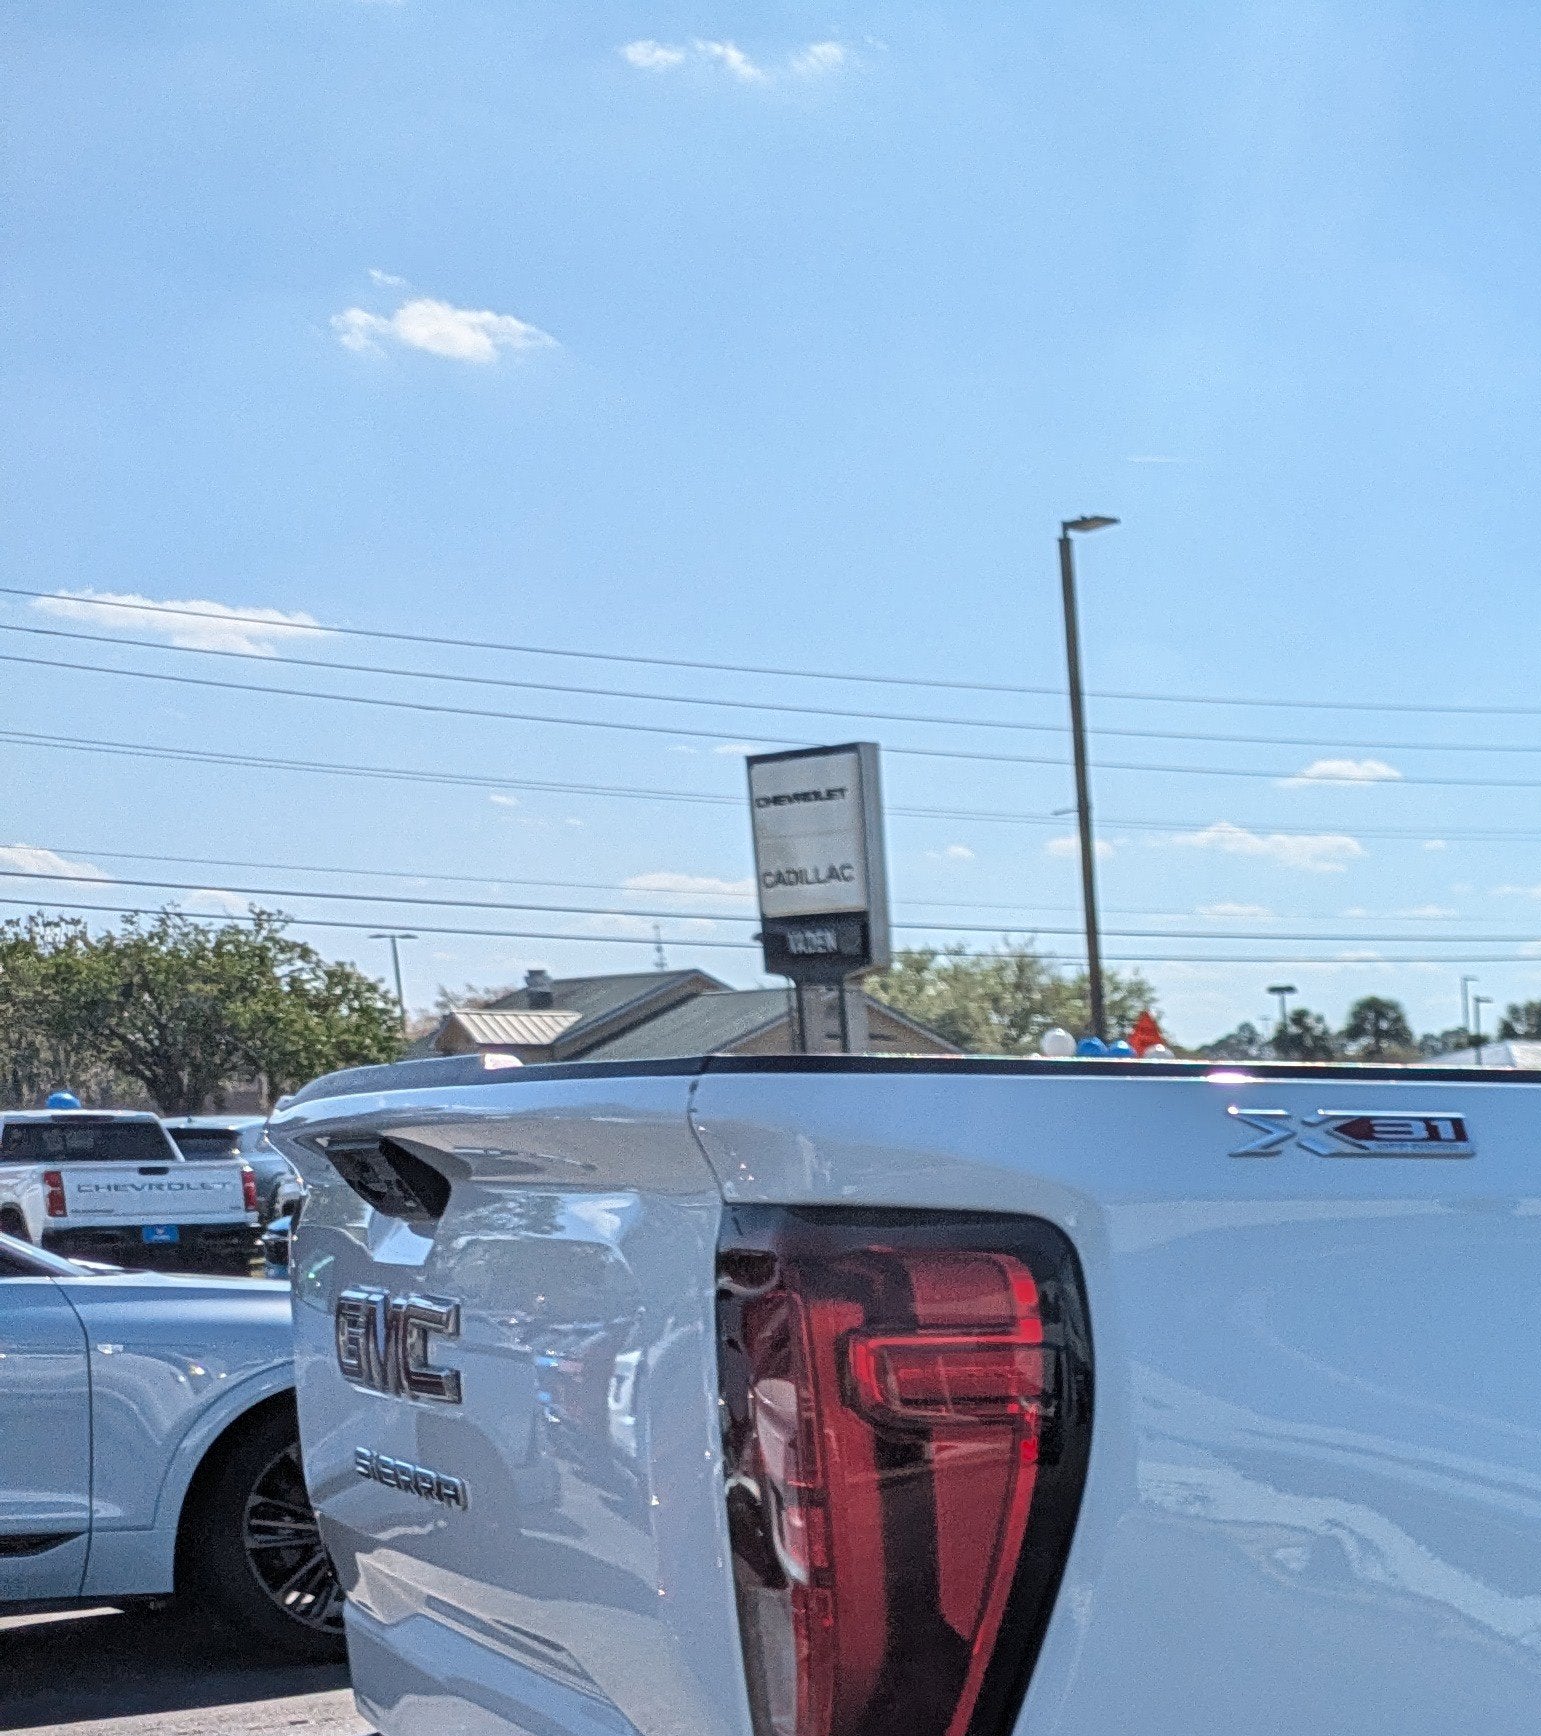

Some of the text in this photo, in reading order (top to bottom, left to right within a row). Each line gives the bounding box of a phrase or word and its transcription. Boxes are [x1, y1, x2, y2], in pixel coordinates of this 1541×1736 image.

[754, 787, 848, 809] CHEVROLET
[762, 863, 854, 889] CADILLAC
[77, 1181, 231, 1194] CHEVROLET
[335, 1284, 463, 1405] GMC
[354, 1446, 469, 1511] SIERRA
